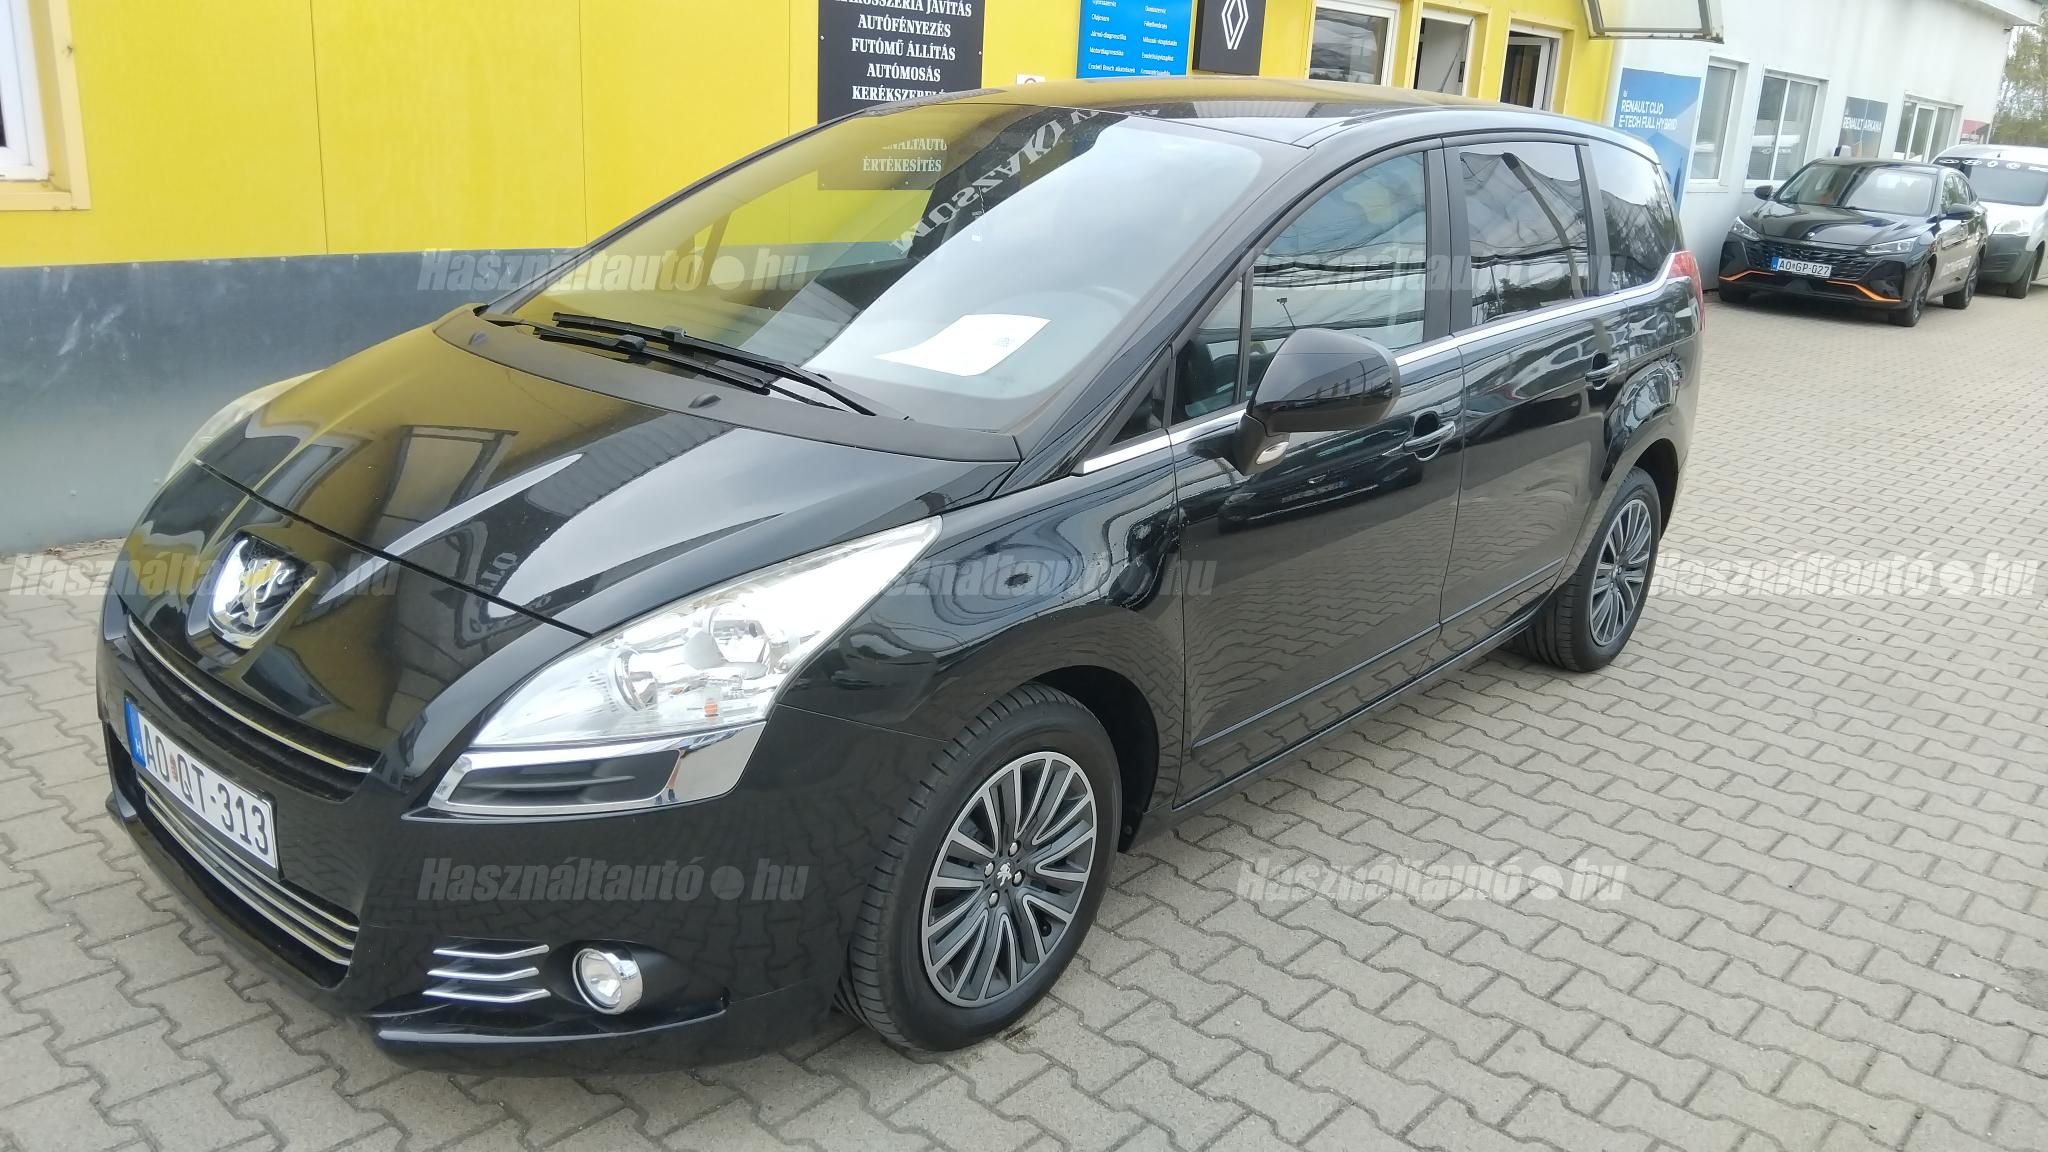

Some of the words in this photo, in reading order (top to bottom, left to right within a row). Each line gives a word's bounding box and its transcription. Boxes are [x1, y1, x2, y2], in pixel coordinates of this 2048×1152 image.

[857, 13, 951, 38] AUTÓFÉNYEZÉS
[851, 37, 905, 56] FUTÓMŰ
[906, 39, 956, 61] ÁLLÍTÁS
[866, 63, 941, 82] AUTÓMOSÁS
[1621, 99, 1649, 114] RENAULT
[1649, 101, 1664, 116] CLIO
[1618, 114, 1641, 128] E-TECH
[1641, 115, 1655, 129] FULL
[1655, 117, 1678, 130] HYBRID
[863, 155, 942, 172] ÉRTÉKESÍTÉS
[144, 724, 170, 783] AO
[177, 753, 269, 856] QT-313
